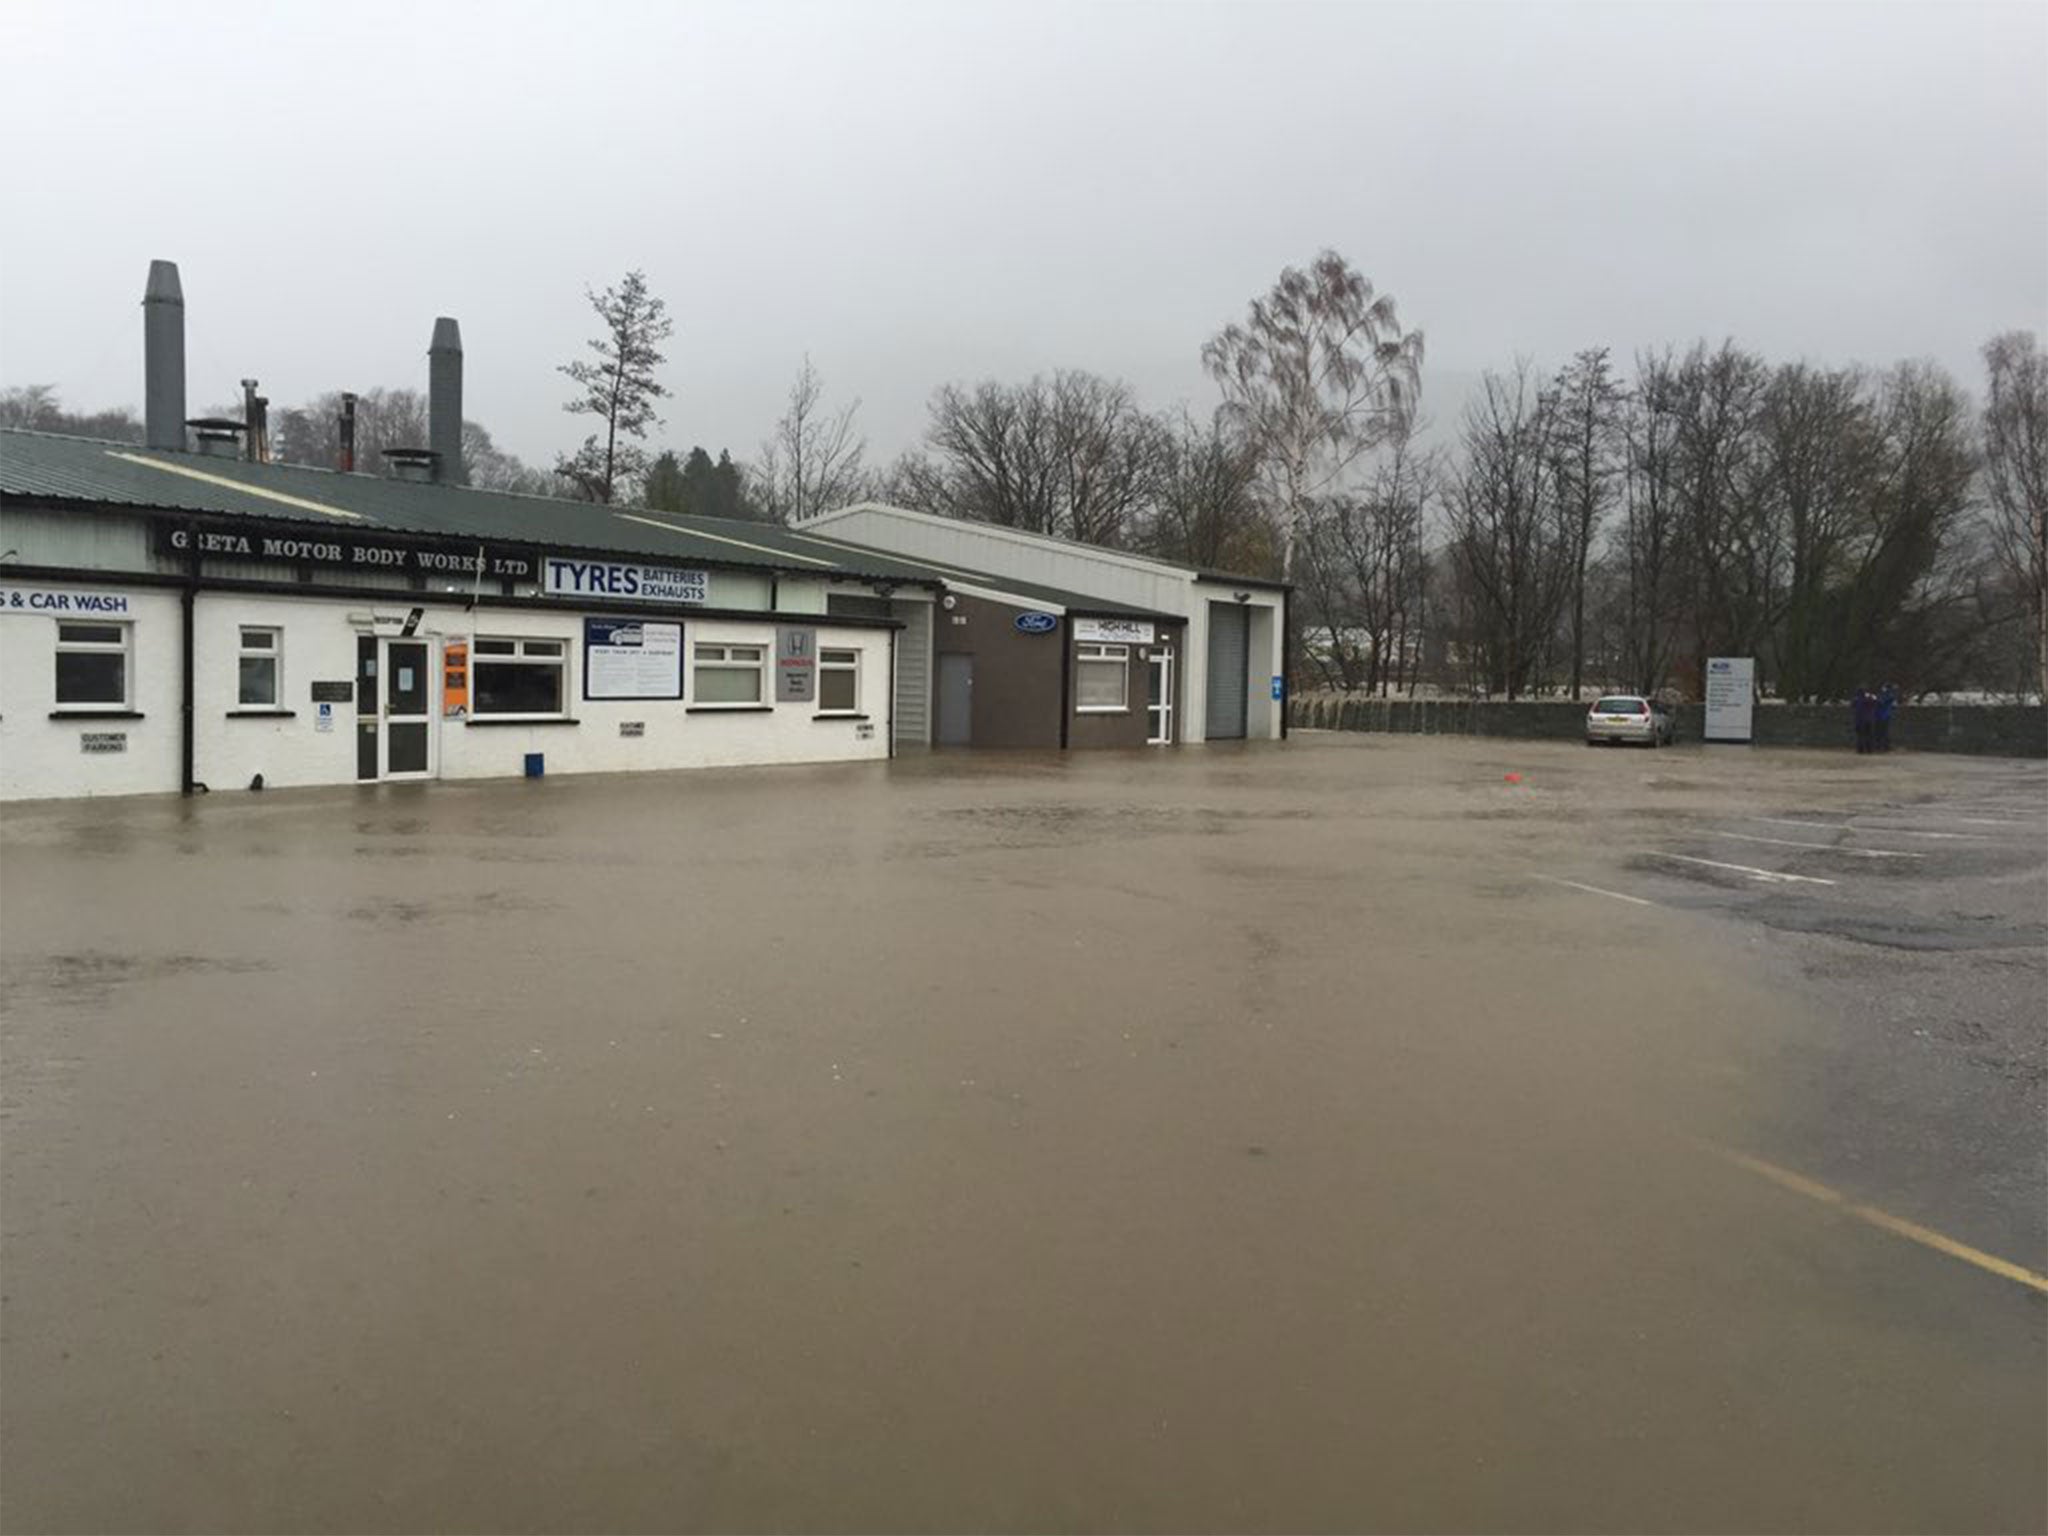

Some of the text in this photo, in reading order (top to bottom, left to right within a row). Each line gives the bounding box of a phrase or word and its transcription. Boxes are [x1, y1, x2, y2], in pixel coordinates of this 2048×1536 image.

[262, 539, 343, 561] MOTOR
[352, 547, 407, 566] BODY
[416, 552, 488, 573] WORKS
[494, 559, 528, 575] LTD
[548, 561, 705, 595] TYRES BATTERIES
[641, 584, 705, 600] EXHAUSTS
[10, 591, 25, 608] &
[29, 593, 71, 610] CAR
[74, 595, 128, 613] WASH
